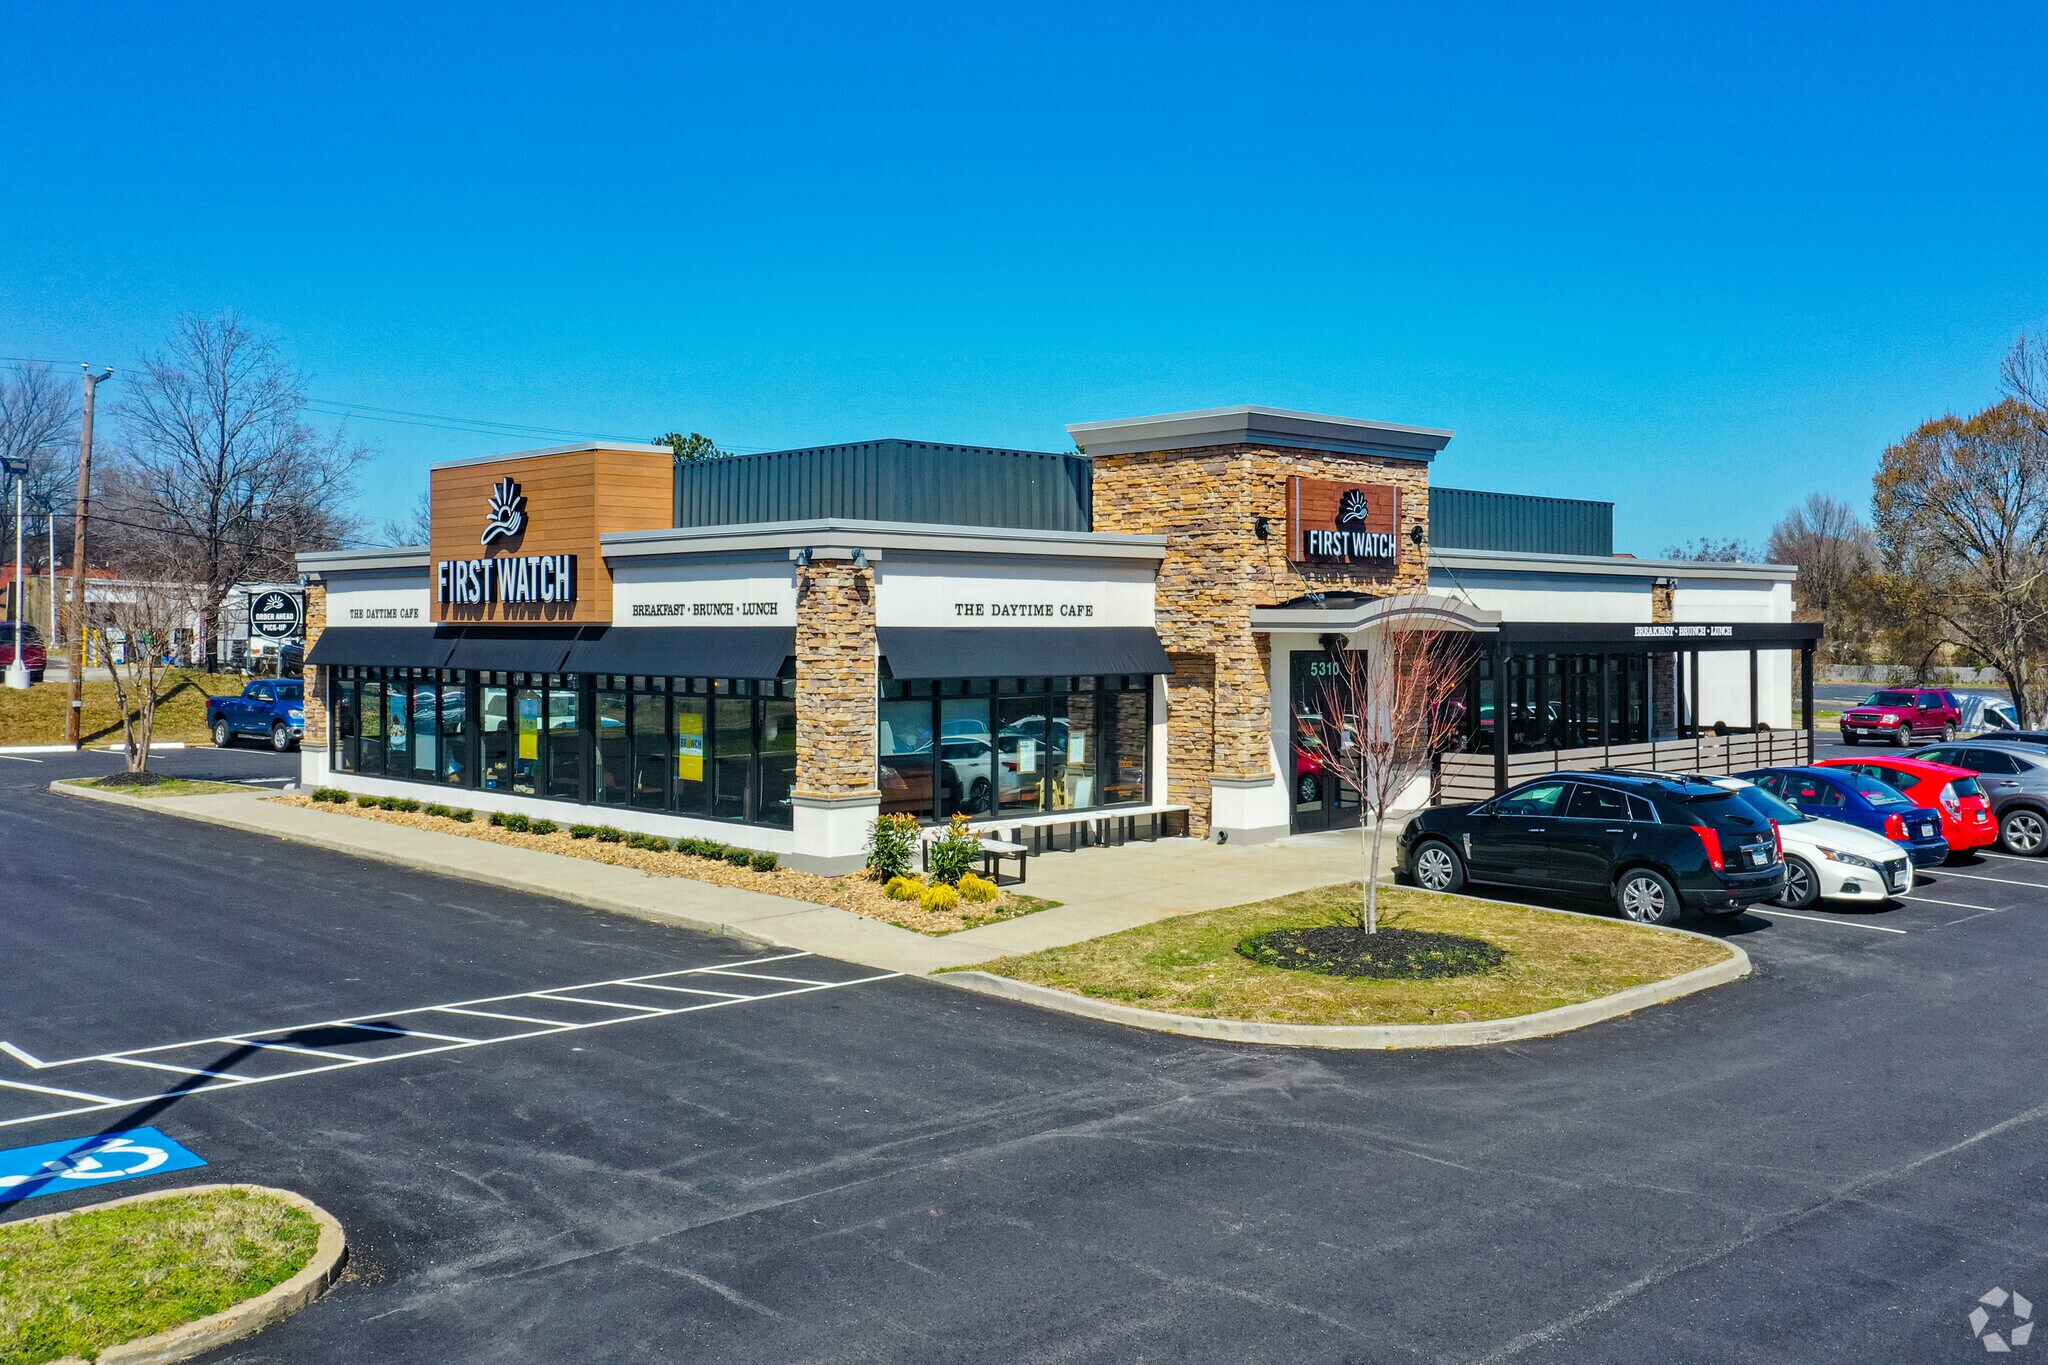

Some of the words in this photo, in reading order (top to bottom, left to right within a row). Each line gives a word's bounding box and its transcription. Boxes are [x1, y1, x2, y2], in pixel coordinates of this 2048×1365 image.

[1310, 530, 1349, 556] FIRST
[1352, 532, 1396, 558] WATCH
[437, 558, 493, 604] FIRST
[497, 554, 570, 603] WATCH
[350, 608, 364, 619] THE
[366, 608, 397, 619] DAYTIME
[400, 608, 419, 619] CAFE
[632, 604, 685, 616] BREAKFAST
[693, 603, 734, 616] BRUNCH
[742, 602, 778, 615] LUNCH
[955, 603, 984, 616] THE
[991, 604, 1053, 616] DAYTIME
[1060, 604, 1093, 617] CAFE
[1634, 626, 1674, 637] BREAKFAST
[1679, 626, 1706, 636] BRUNCH
[1711, 626, 1732, 636] LUNCH
[1310, 661, 1340, 676] 5310
